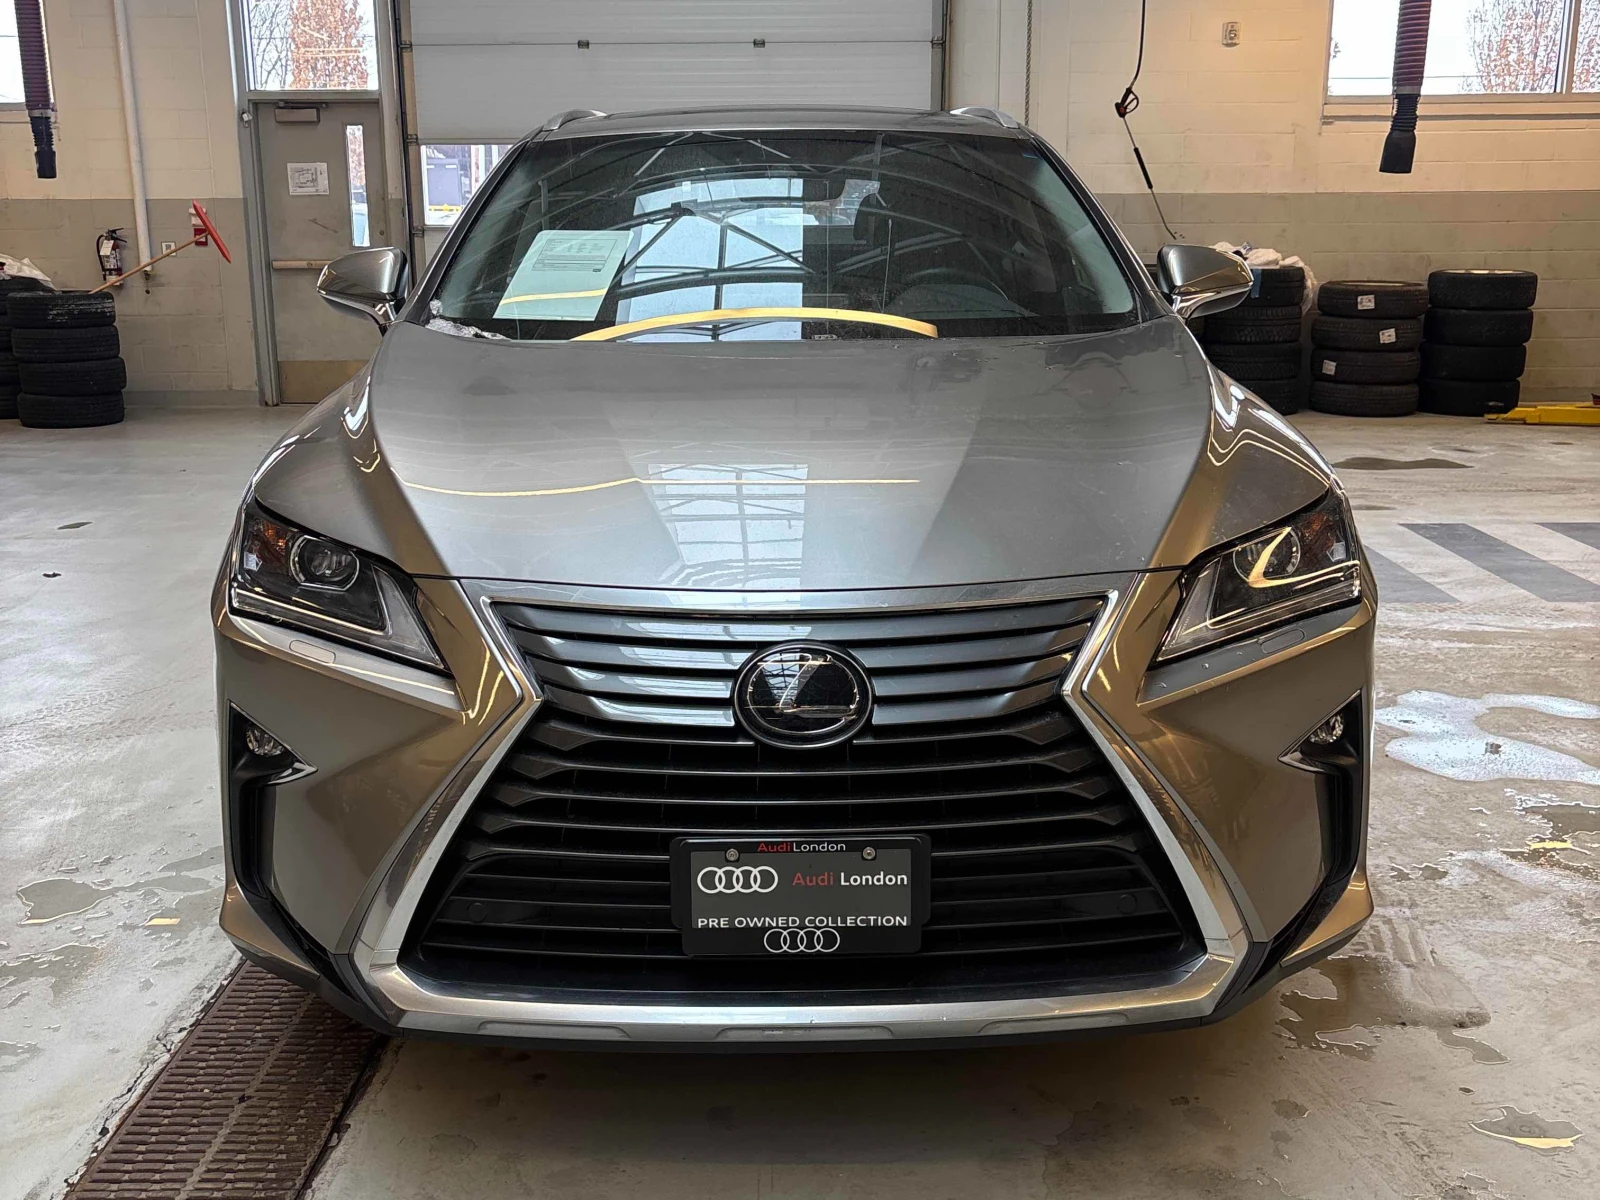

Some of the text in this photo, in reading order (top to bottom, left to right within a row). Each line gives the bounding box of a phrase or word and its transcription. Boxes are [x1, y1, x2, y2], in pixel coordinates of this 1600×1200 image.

[792, 871, 908, 886] Audi London
[697, 915, 908, 929] PRE OWNED COLLECTION
